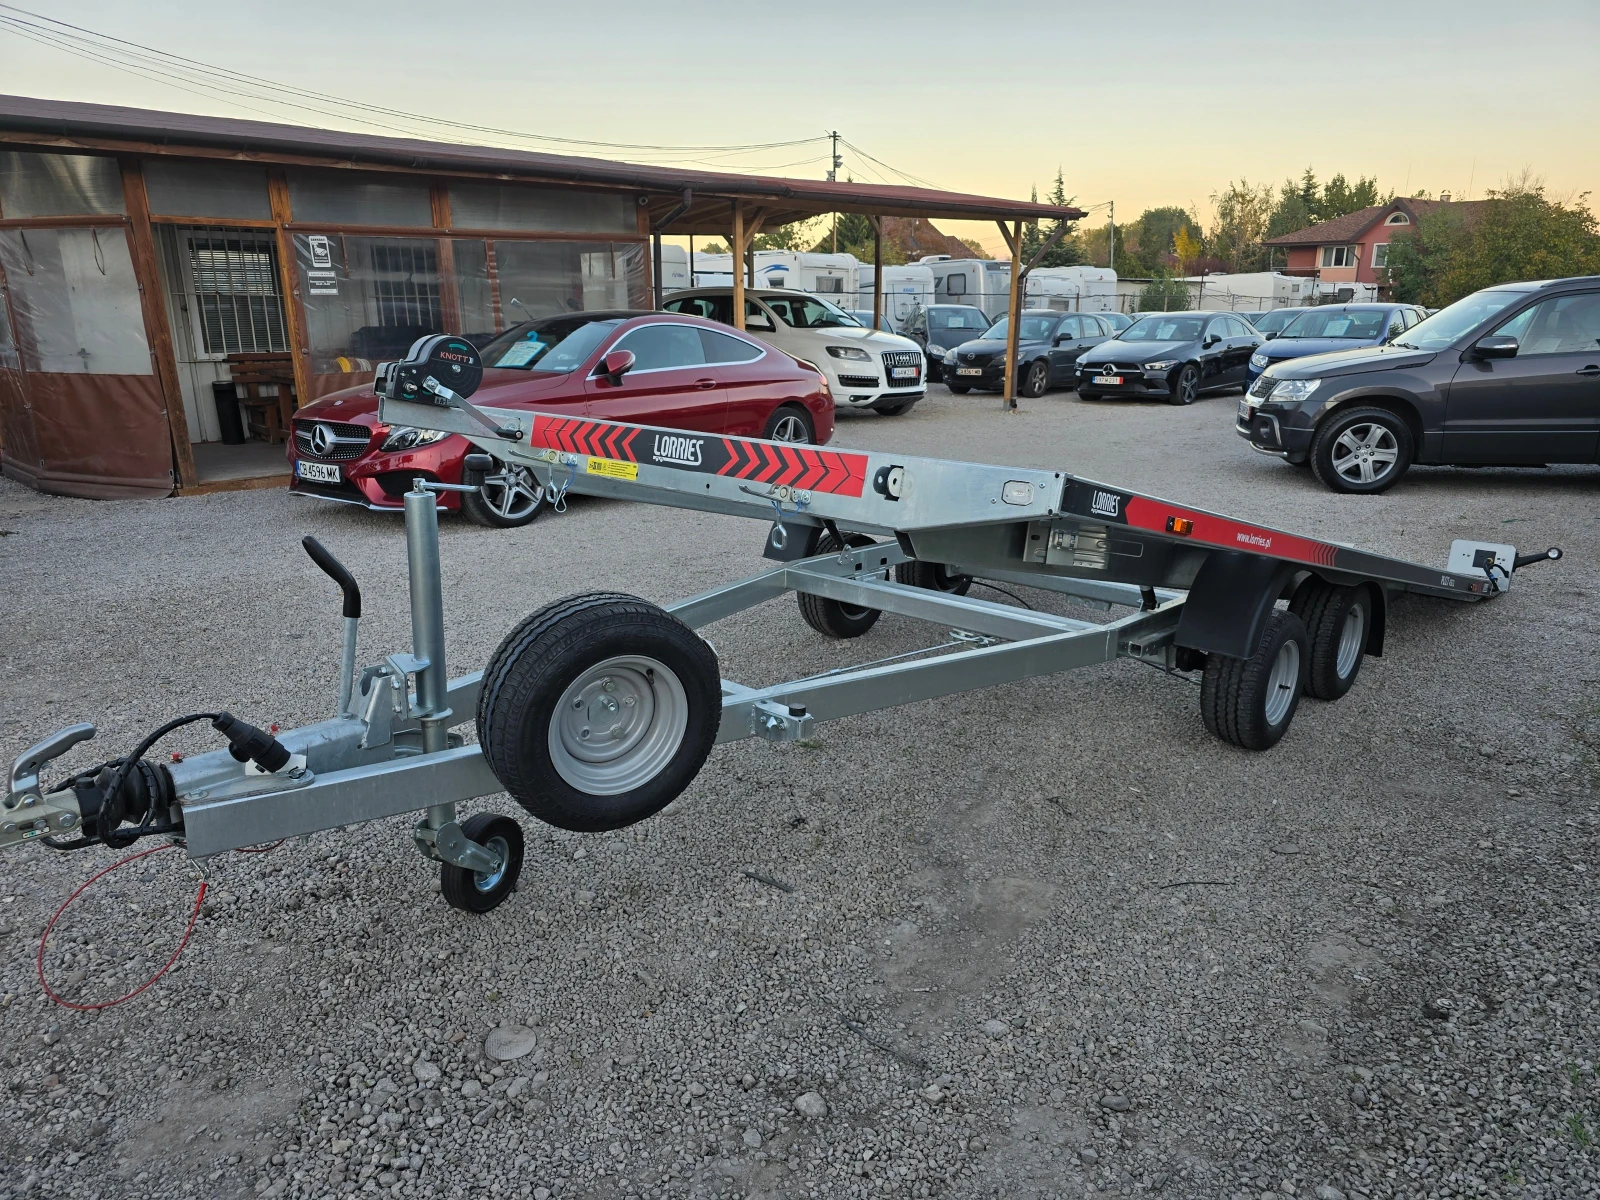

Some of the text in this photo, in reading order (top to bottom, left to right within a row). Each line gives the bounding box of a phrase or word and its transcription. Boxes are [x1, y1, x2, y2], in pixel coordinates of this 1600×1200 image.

[440, 351, 468, 363] KNOTT
[653, 434, 704, 465] LORRIES
[308, 464, 326, 479] 4596
[326, 467, 338, 481] MK
[1091, 490, 1120, 516] LORRIES
[1236, 532, 1272, 549] www.lorries.pl
